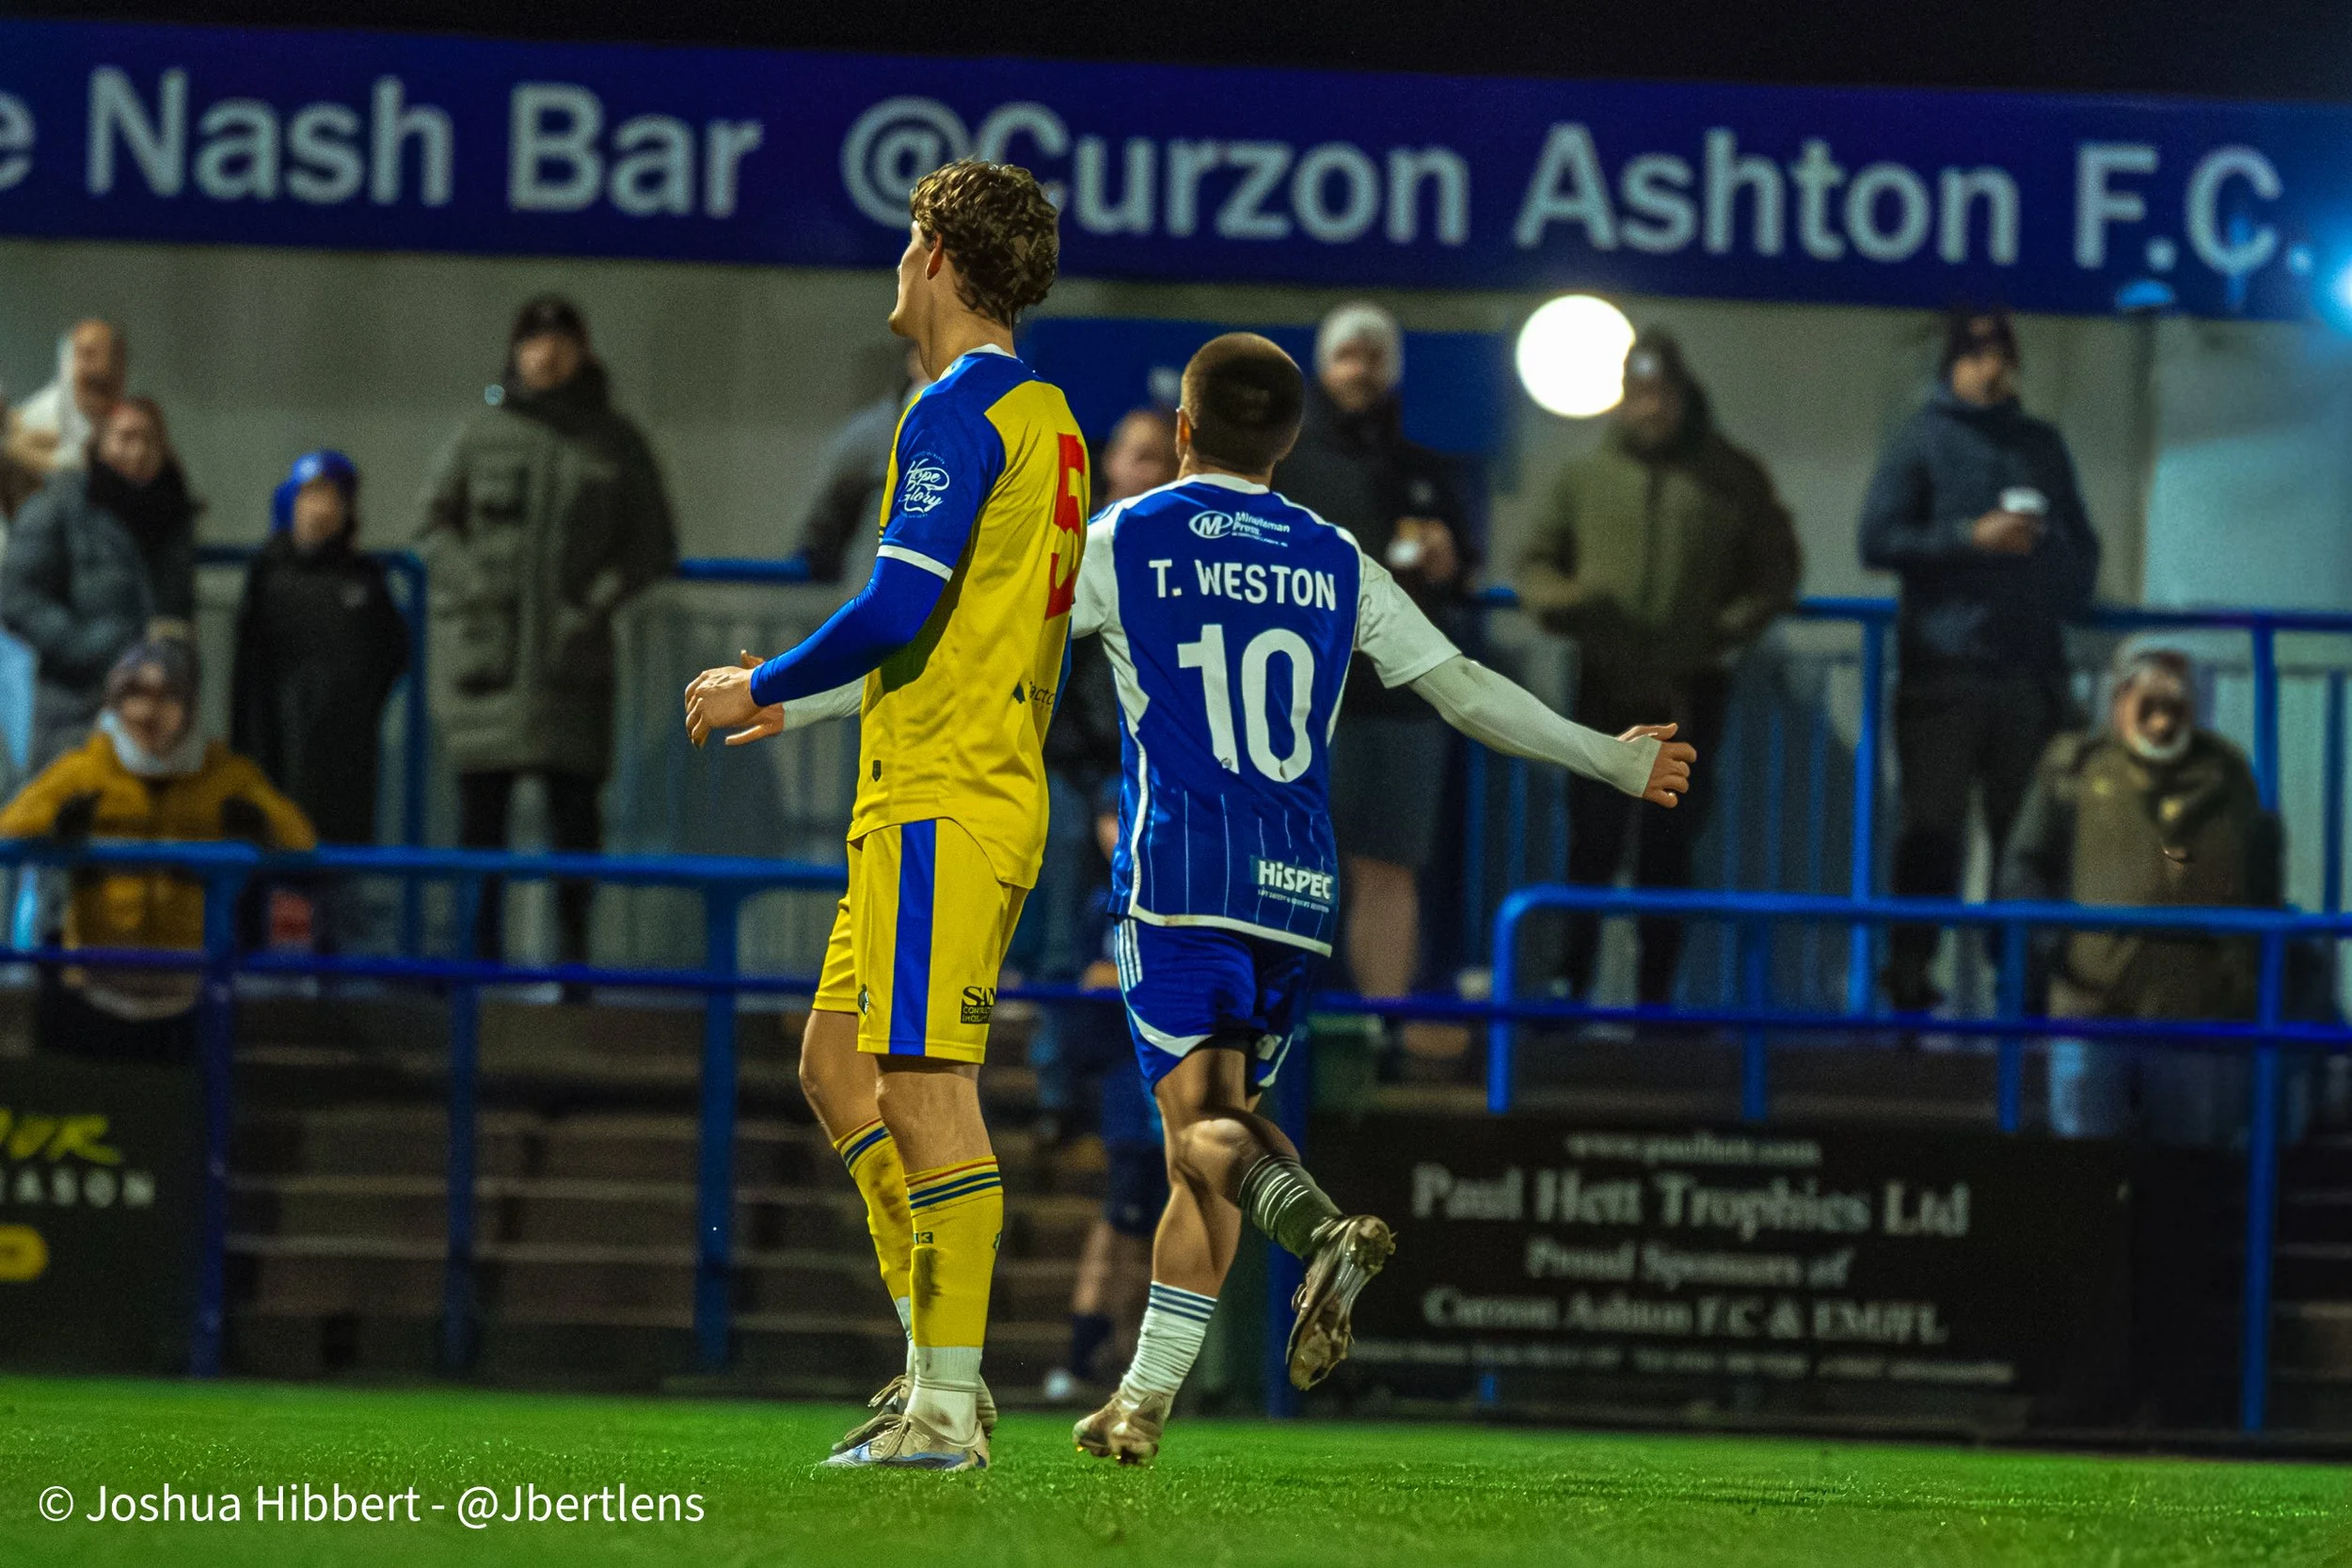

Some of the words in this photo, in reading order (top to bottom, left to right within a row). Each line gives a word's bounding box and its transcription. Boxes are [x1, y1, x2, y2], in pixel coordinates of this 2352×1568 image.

[86, 65, 455, 206] Nash
[506, 82, 764, 218] Bar
[1515, 121, 2020, 264] Ashton
[1044, 432, 1086, 621] 5
[1148, 559, 1183, 598] T.
[1194, 559, 1337, 611] WESTON
[1177, 624, 1314, 784] 10
[1885, 1180, 1970, 1237] Ltd
